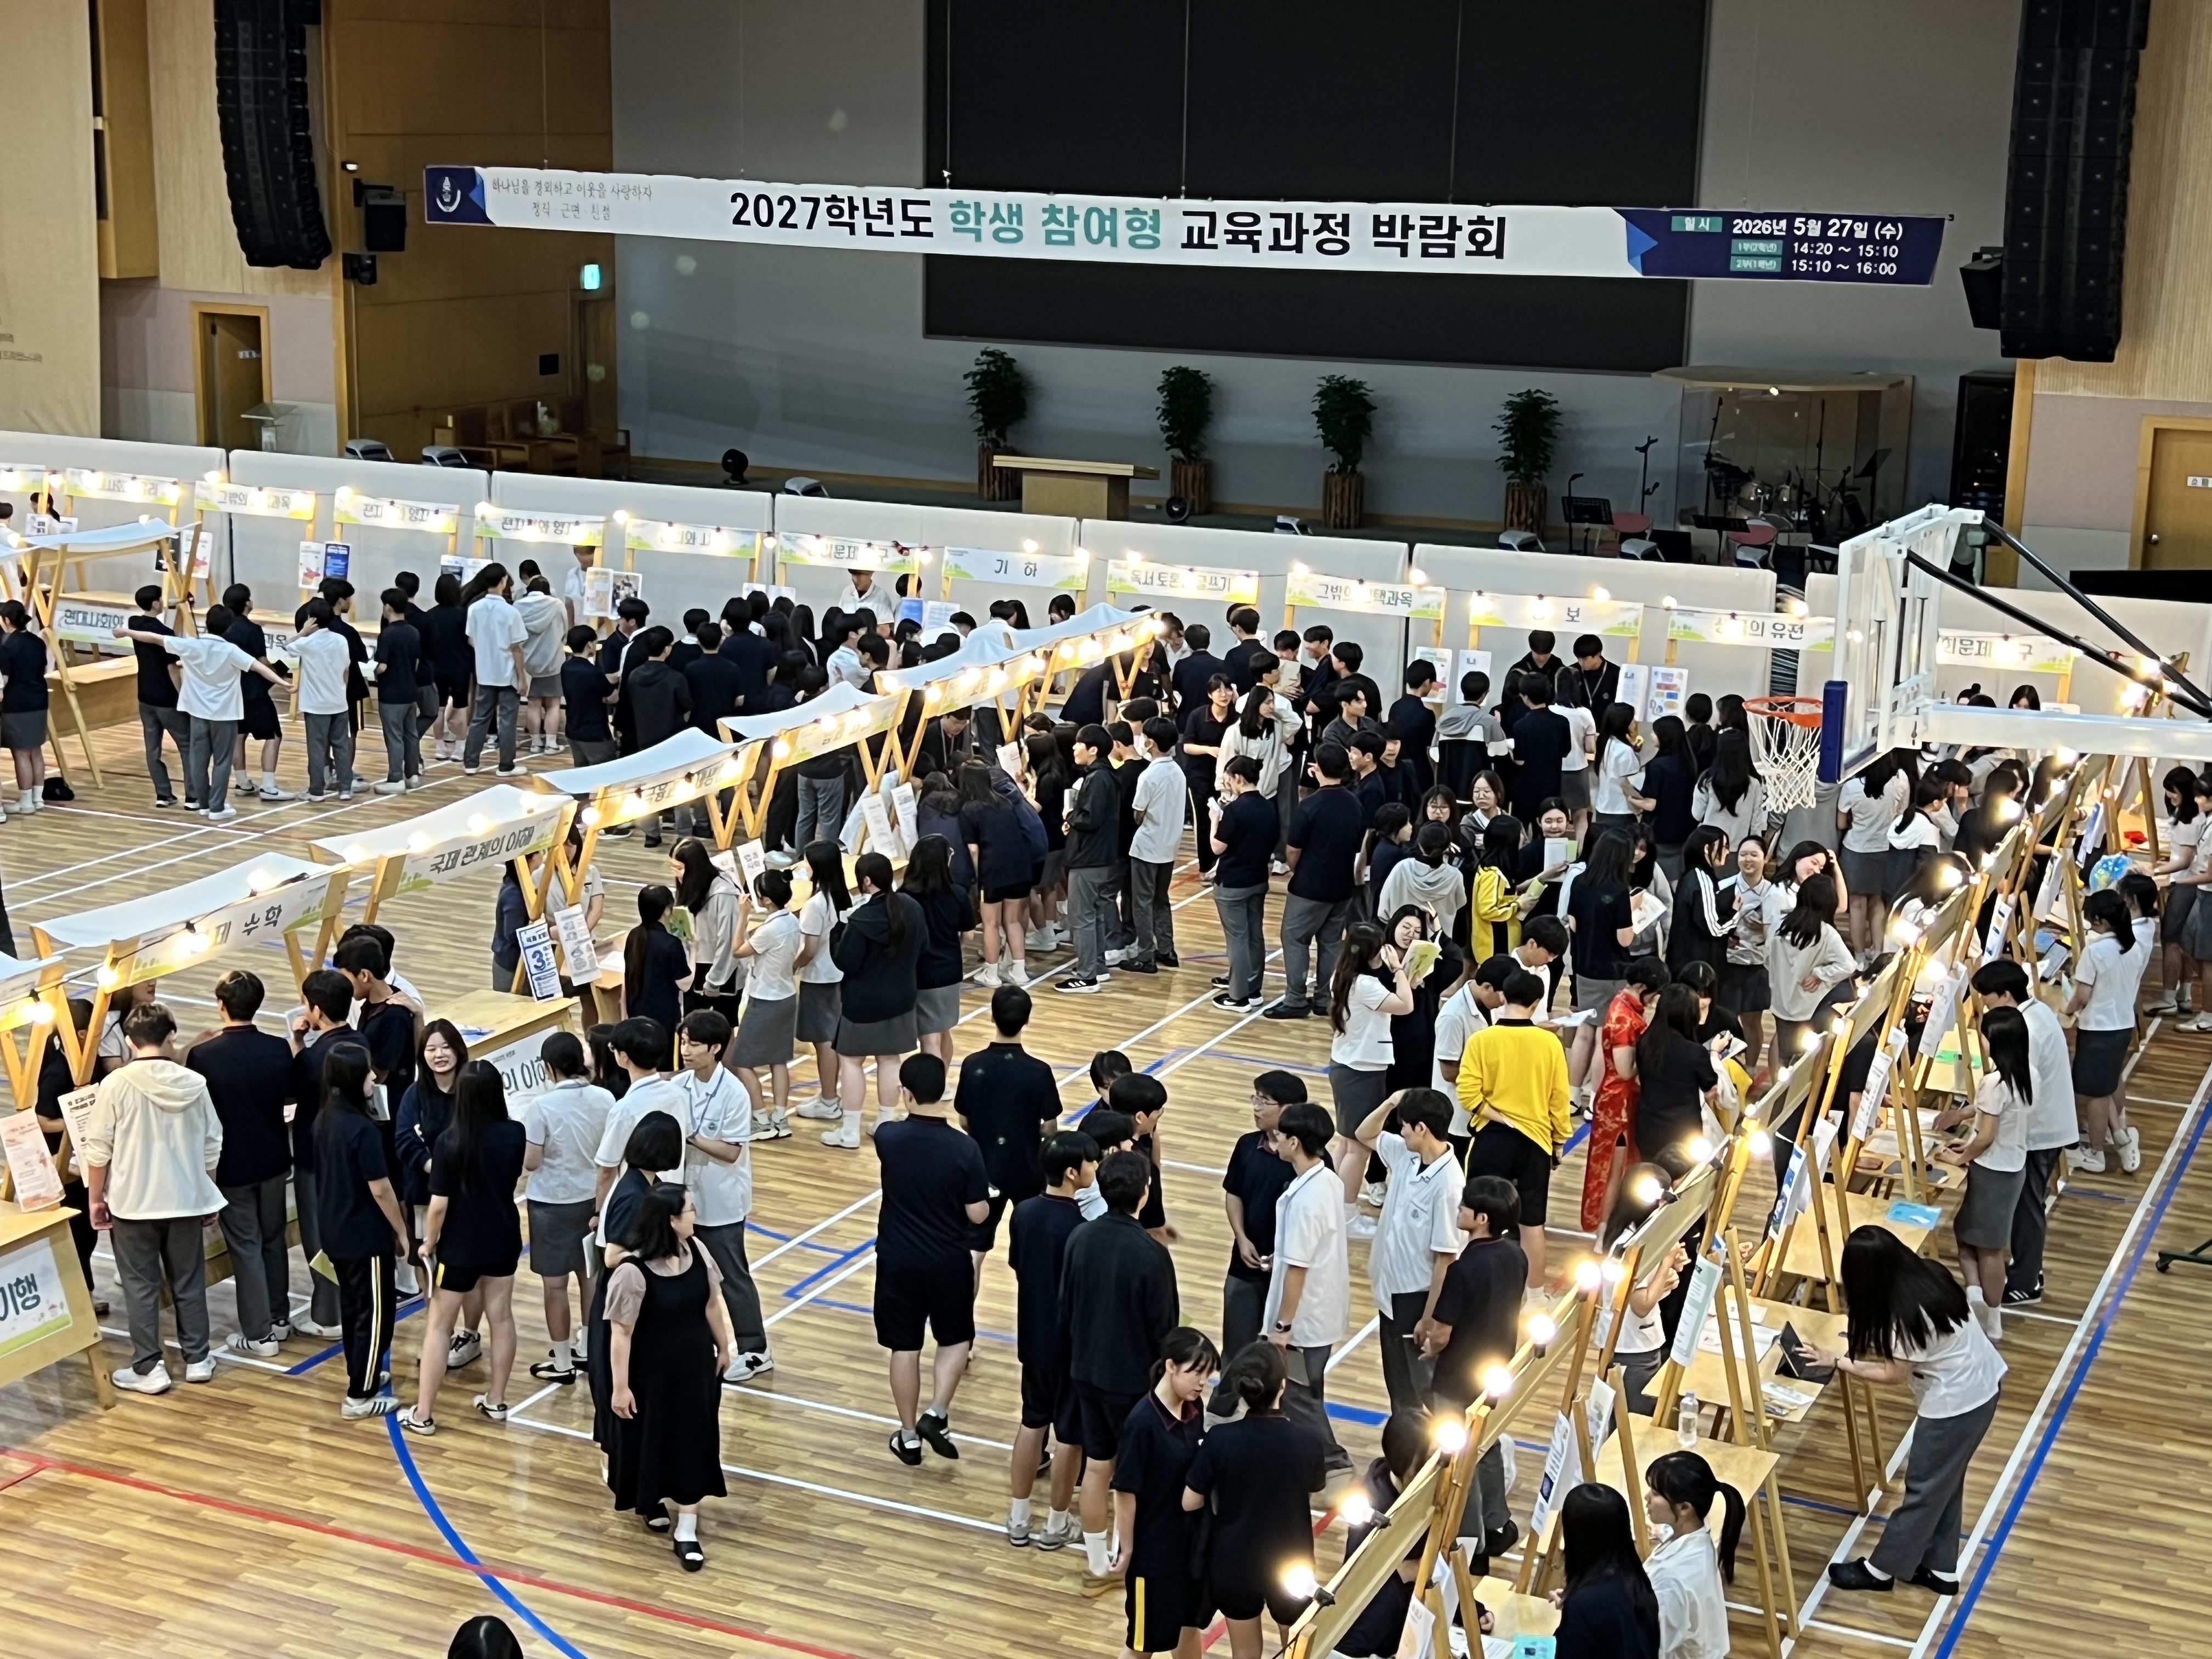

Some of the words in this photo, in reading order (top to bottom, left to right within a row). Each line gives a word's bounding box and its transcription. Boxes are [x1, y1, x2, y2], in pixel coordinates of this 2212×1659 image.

[493, 177, 529, 195] 하나님을
[534, 179, 573, 196] 경외하고
[577, 180, 606, 199] 이웃을
[610, 182, 652, 201] 사랑하자
[532, 202, 551, 217] 정직
[561, 203, 580, 219] 근면
[730, 192, 933, 238] 2027학년도
[949, 200, 1024, 245] 학생
[1041, 203, 1160, 250] 참여형
[1180, 210, 1351, 256] 교육과정
[1372, 213, 1506, 259] 박람회
[1733, 218, 1787, 235] 2026년
[1793, 217, 1822, 237] 5월
[1827, 218, 1869, 239] 27일
[1874, 221, 1903, 240] (수)
[1793, 242, 1833, 255] 14:20
[1858, 244, 1899, 258] 15:10
[1792, 259, 1832, 273] 15:10
[1856, 262, 1898, 275] 16:00
[1770, 622, 1804, 640] 유전
[242, 904, 282, 936] 수학
[531, 949, 546, 971] 3
